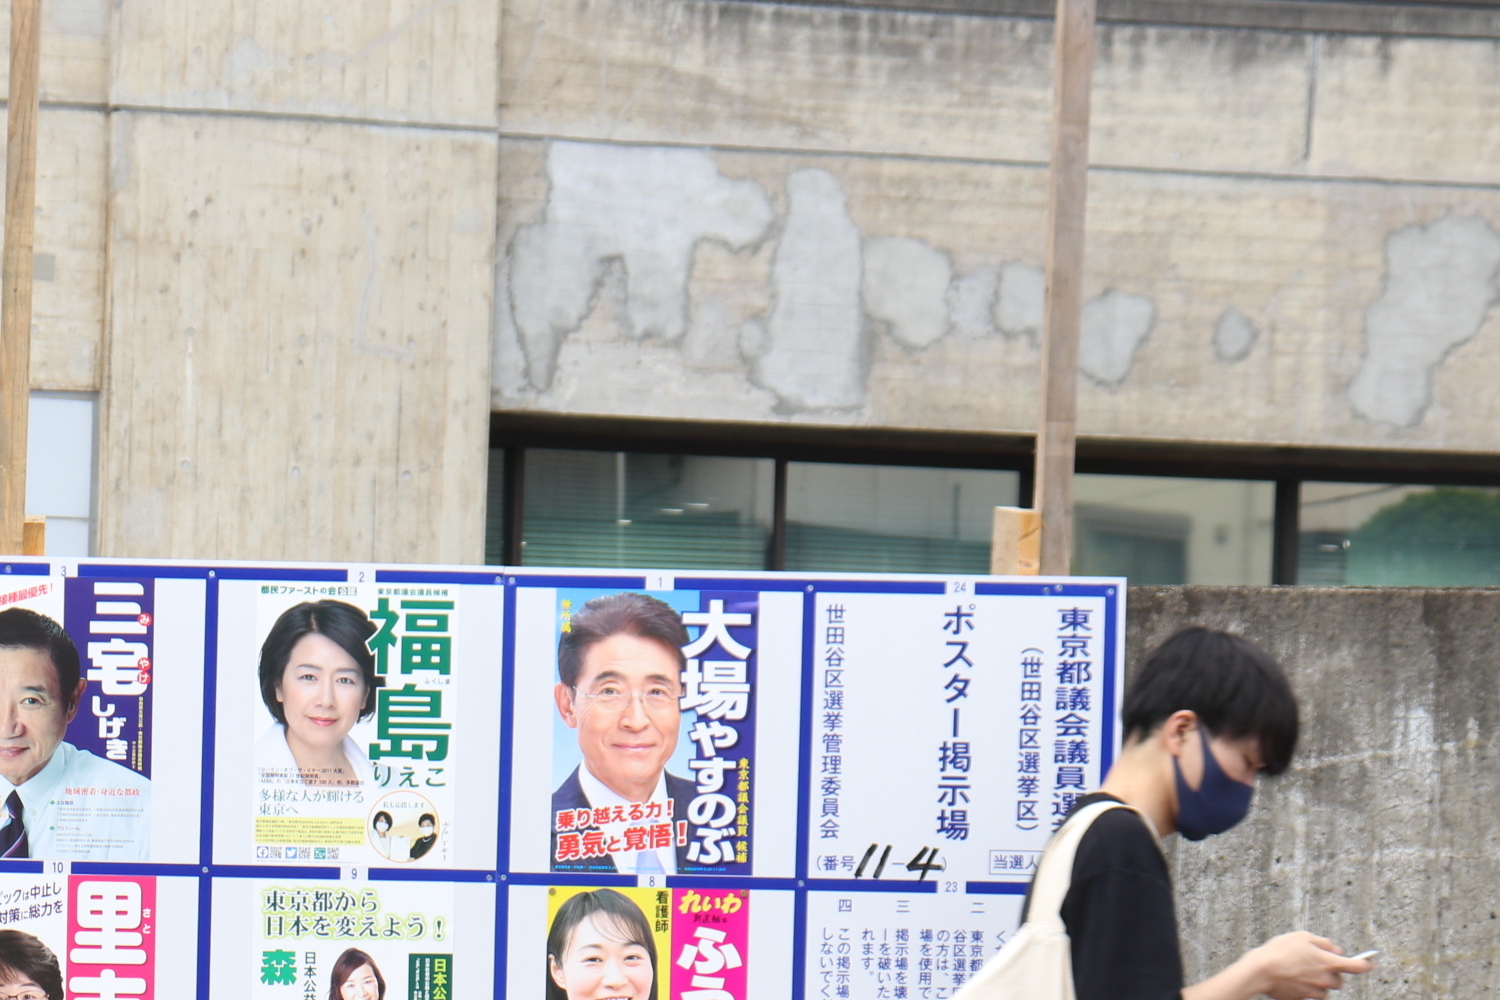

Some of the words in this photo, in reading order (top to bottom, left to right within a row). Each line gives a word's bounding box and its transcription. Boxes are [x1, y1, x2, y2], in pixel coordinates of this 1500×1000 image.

[60, 565, 67, 577] 3
[358, 572, 366, 582] 2
[261, 585, 336, 595] 都民ファーストの会
[377, 588, 449, 597] 東京都議会議員候補
[954, 581, 967, 593] 24
[560, 598, 572, 633] 無所属
[87, 581, 150, 696] 三宅
[366, 597, 455, 761] 福島
[91, 695, 129, 760] しげき
[678, 599, 752, 864] 大場やすのぶ
[820, 603, 846, 839] 世田谷区選挙管理委員会
[936, 603, 976, 841] ポスター掲示場
[1051, 607, 1094, 833] 東京都議会議員選
[1015, 646, 1044, 832] （世田谷区選挙区）
[372, 766, 447, 788] りえこ
[64, 787, 141, 797] 地域密着・身近な都政
[259, 788, 364, 804] 多様な人が輝ける
[382, 800, 426, 809] 私も応援します
[258, 803, 299, 816] 東京へ
[557, 799, 674, 832] 乗り越える力！
[555, 821, 688, 862] 勇気と覚悟！
[52, 861, 64, 873] 10
[351, 869, 358, 880] 9
[649, 877, 656, 888] 8
[945, 882, 958, 893] 23
[264, 888, 379, 914] 東京都から
[655, 890, 669, 933] 看護師
[678, 889, 742, 914] れいわ
[142, 907, 152, 934] さと
[265, 915, 444, 940] 日本を変えよう！
[861, 928, 875, 977] れます。
[260, 948, 298, 986] 森
